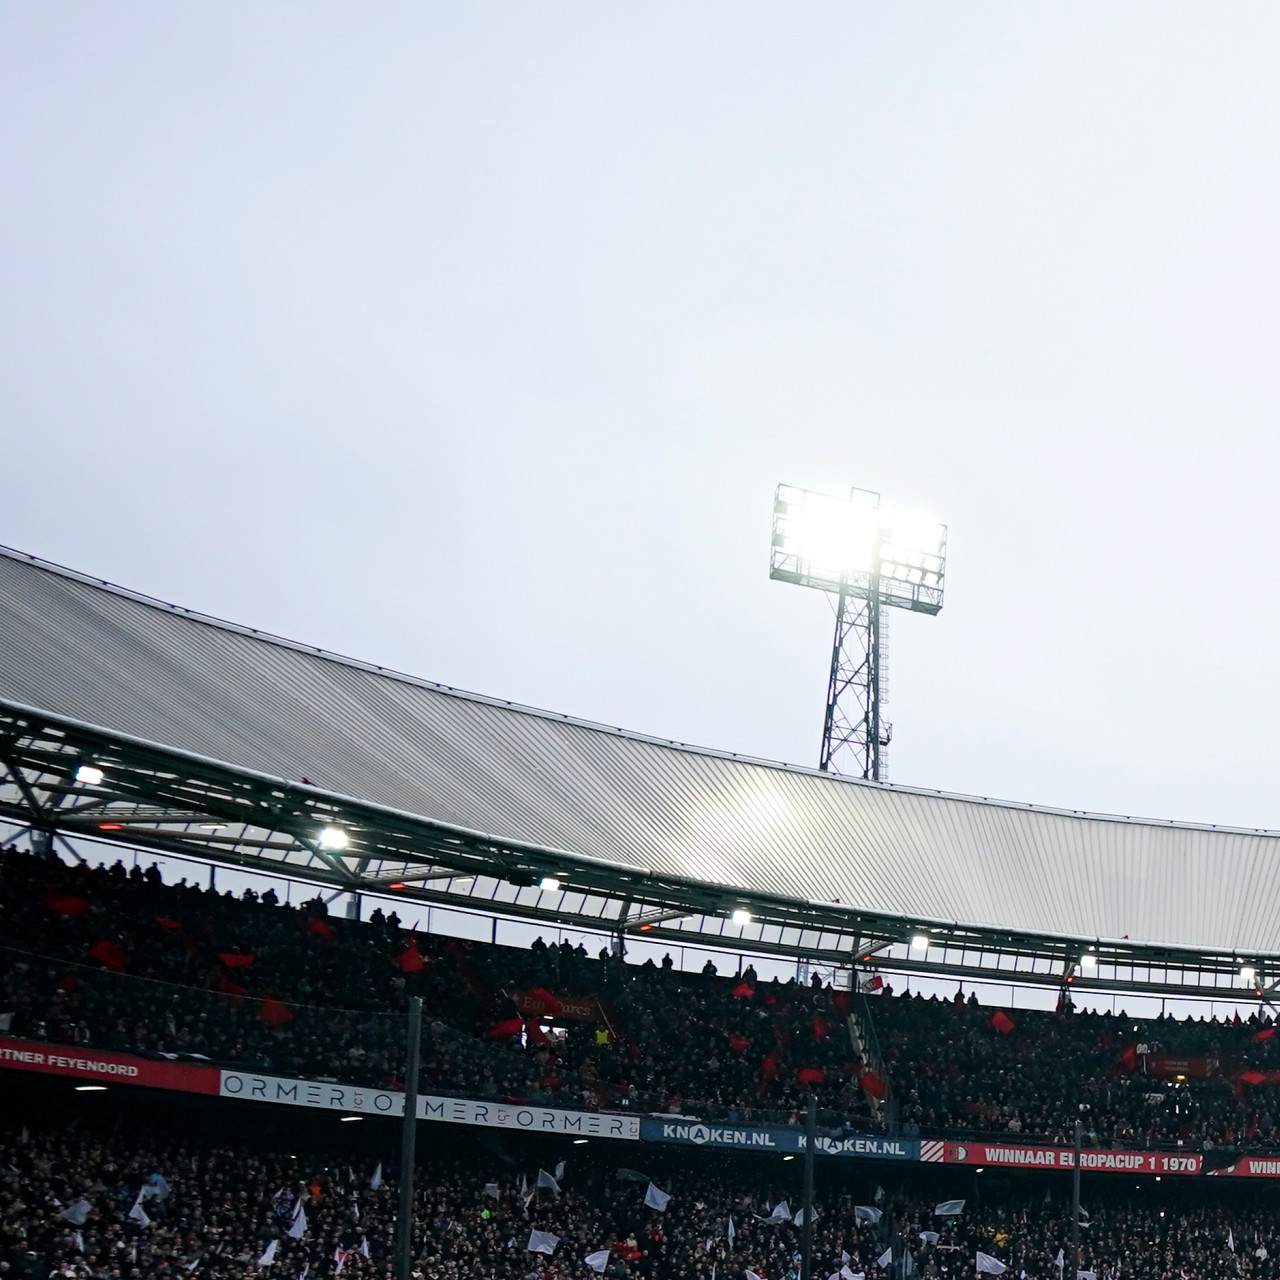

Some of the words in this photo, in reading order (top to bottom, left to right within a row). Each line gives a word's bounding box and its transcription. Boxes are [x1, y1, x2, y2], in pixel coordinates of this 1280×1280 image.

[0, 1048, 44, 1065] TNER
[47, 1054, 139, 1077] FEYENOORD
[224, 1075, 345, 1108] ORMER
[374, 1094, 489, 1122] OMER
[516, 1110, 624, 1135] ORMER
[663, 1124, 776, 1147] KNAKEN.NL
[985, 1147, 1055, 1166] WINNAAR
[1148, 1157, 1156, 1169] 1
[1161, 1158, 1197, 1171] 1970
